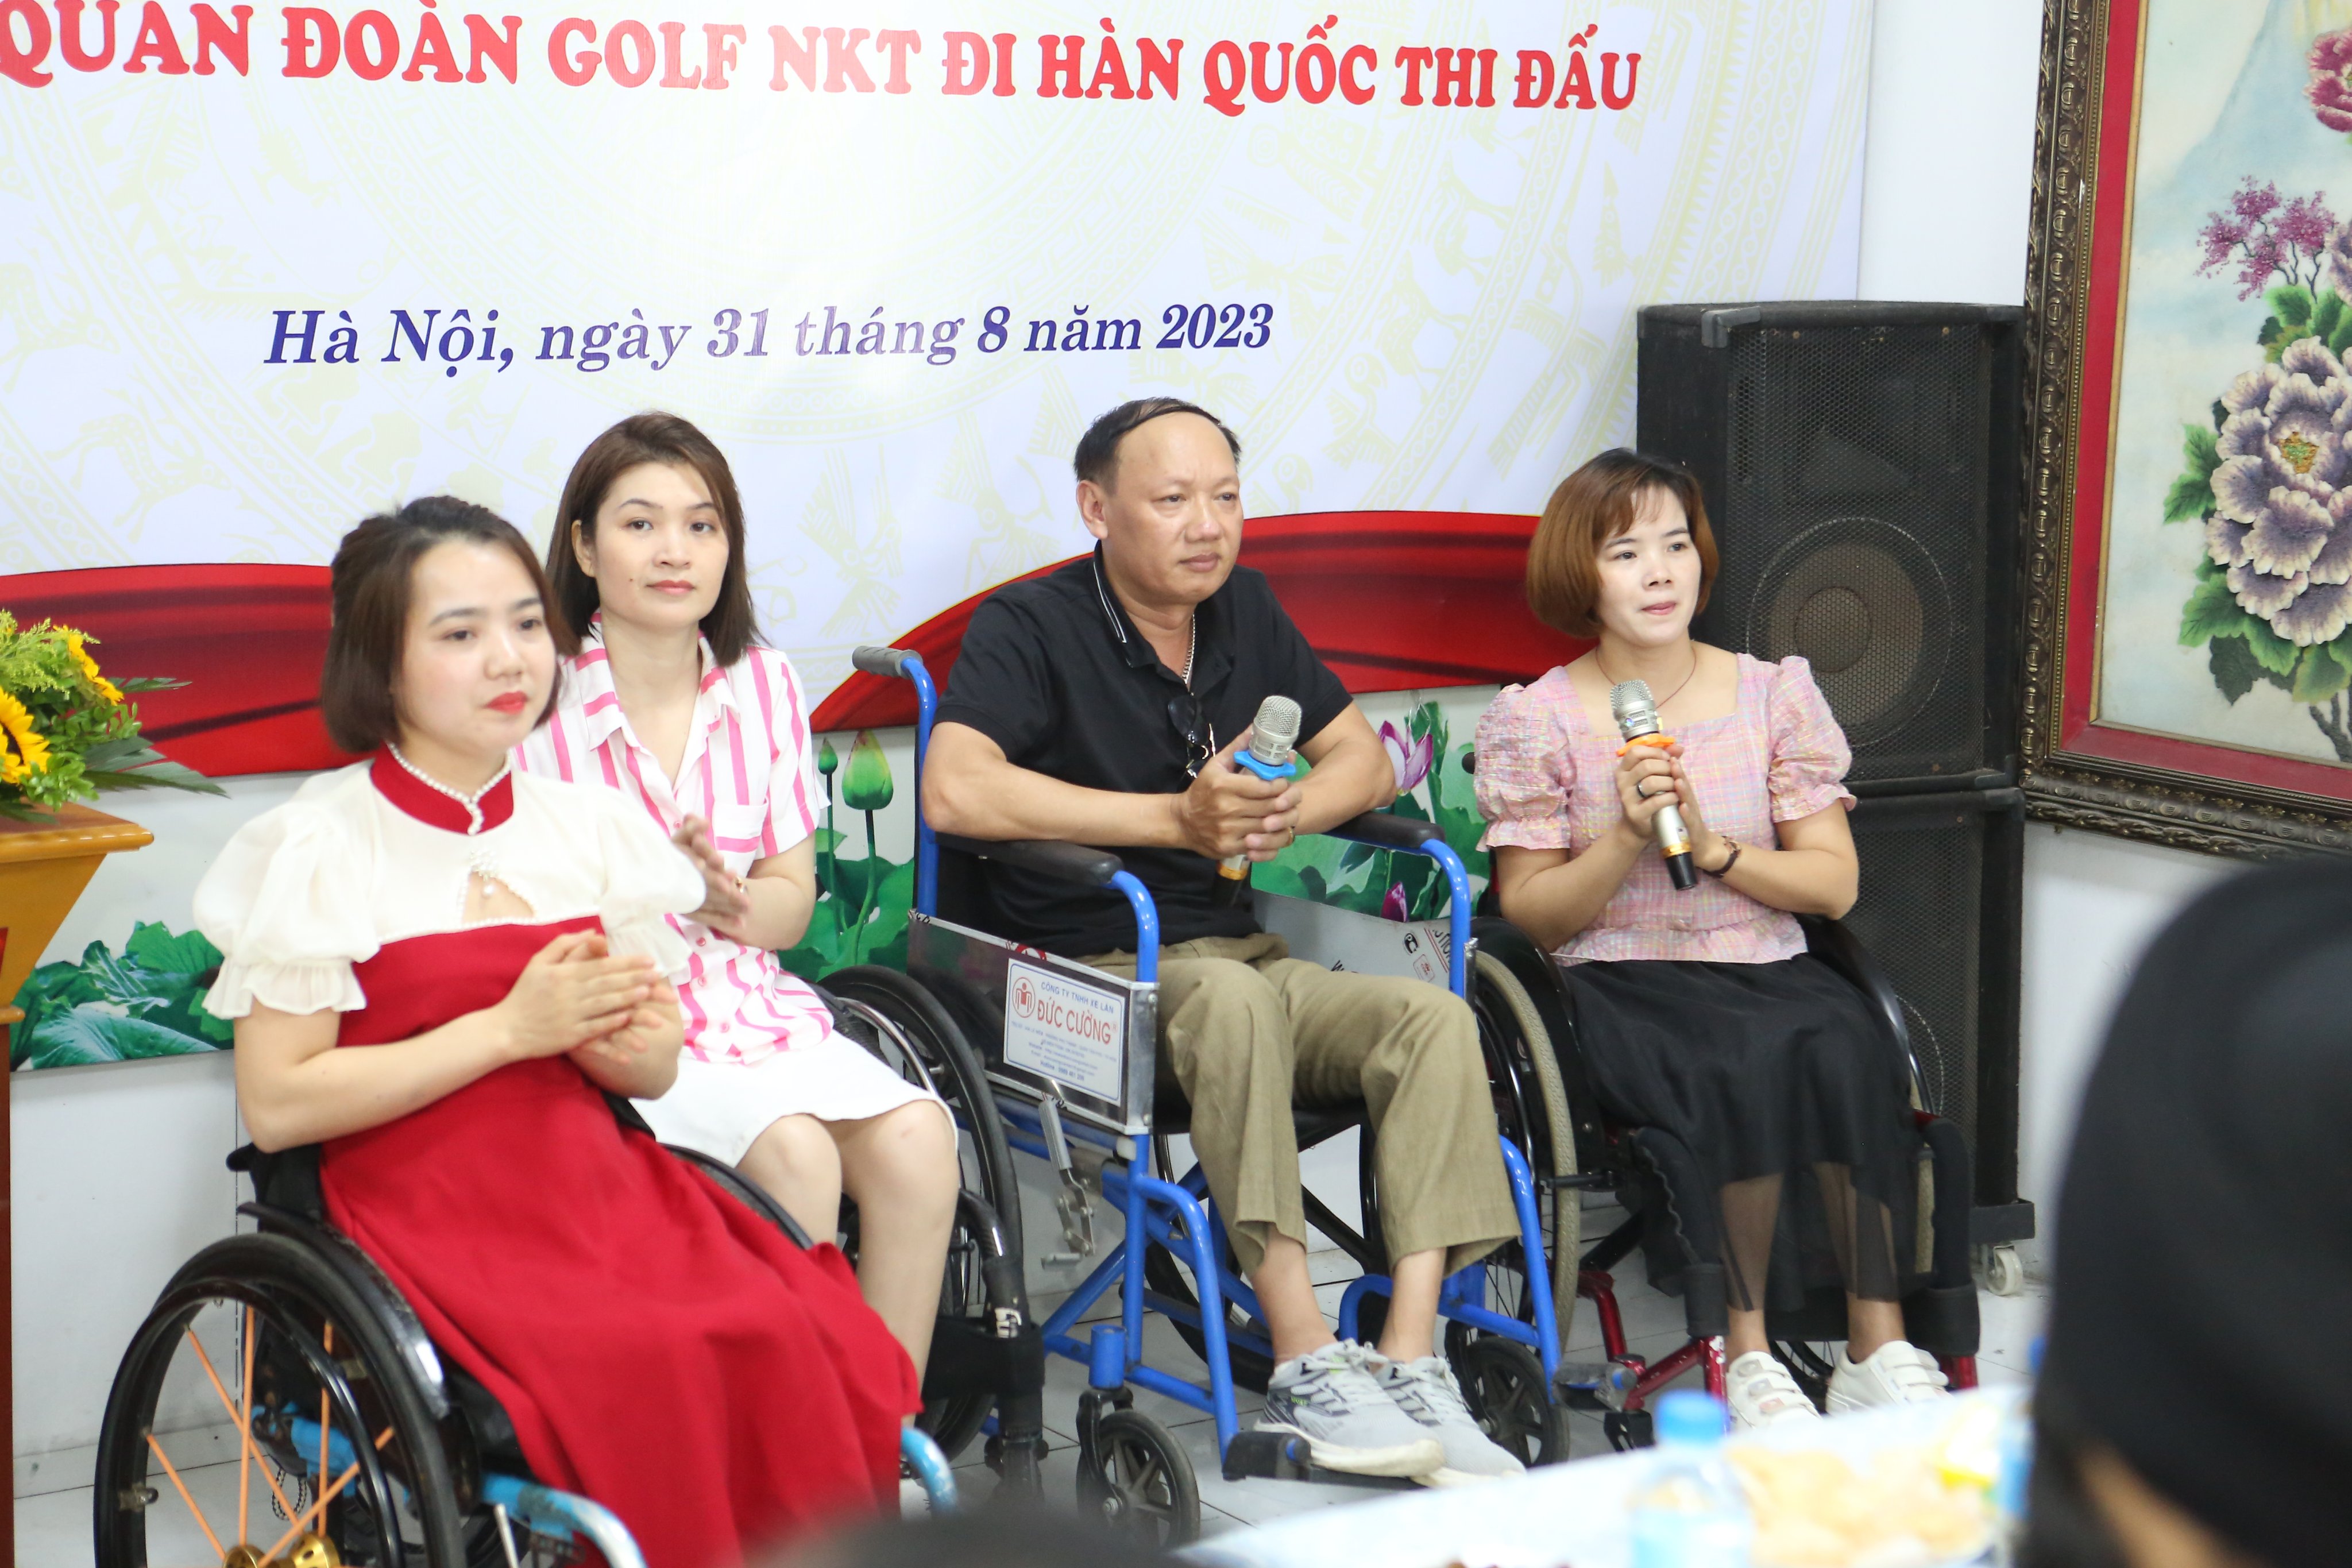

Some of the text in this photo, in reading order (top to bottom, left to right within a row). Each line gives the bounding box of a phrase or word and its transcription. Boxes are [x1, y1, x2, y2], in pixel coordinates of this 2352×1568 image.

[0, 0, 1641, 117] QUAN ĐOÀN GOLF NKT ĐI HÀN QUỐC THI ĐẤU
[264, 303, 1273, 377] Hà Nội, ngày 31 tháng 8 năm 2023
[1037, 997, 1063, 1028] ĐỨC
[1067, 1010, 1111, 1045] CƯỜNG
[1041, 982, 1060, 995] CÔNG
[1062, 989, 1069, 998] TY
[1072, 992, 1088, 1004] TNHH
